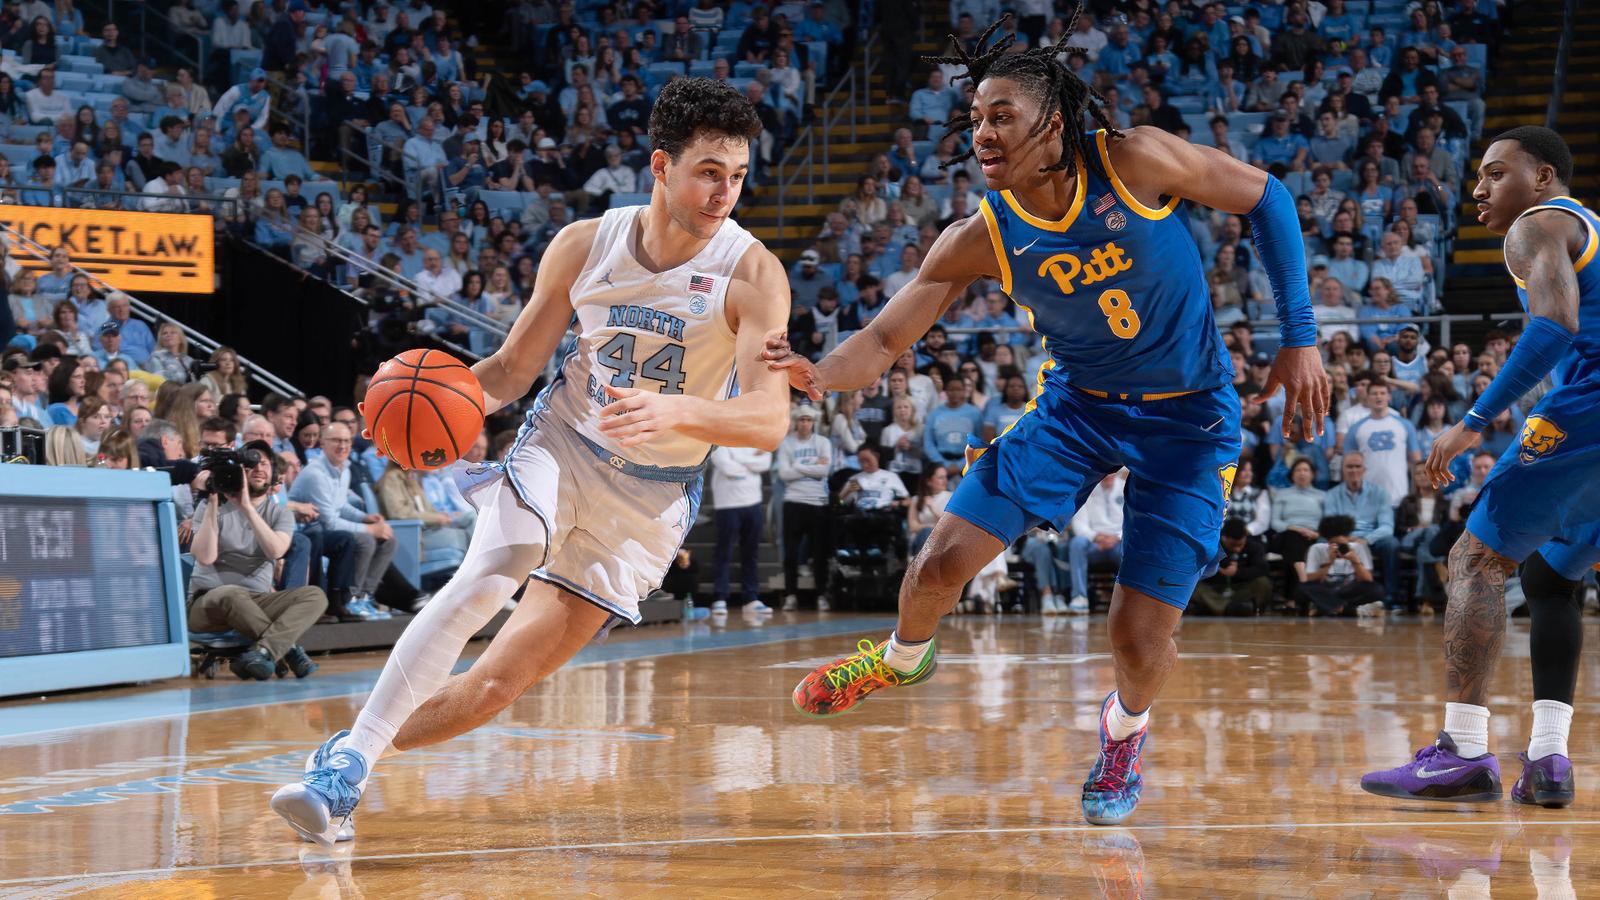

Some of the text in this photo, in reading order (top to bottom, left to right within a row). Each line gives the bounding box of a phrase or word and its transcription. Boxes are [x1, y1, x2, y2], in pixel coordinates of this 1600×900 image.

[1037, 241, 1133, 295] Pitt
[606, 304, 686, 342] NORTH
[1098, 288, 1141, 339] 8
[597, 332, 687, 395] 44
